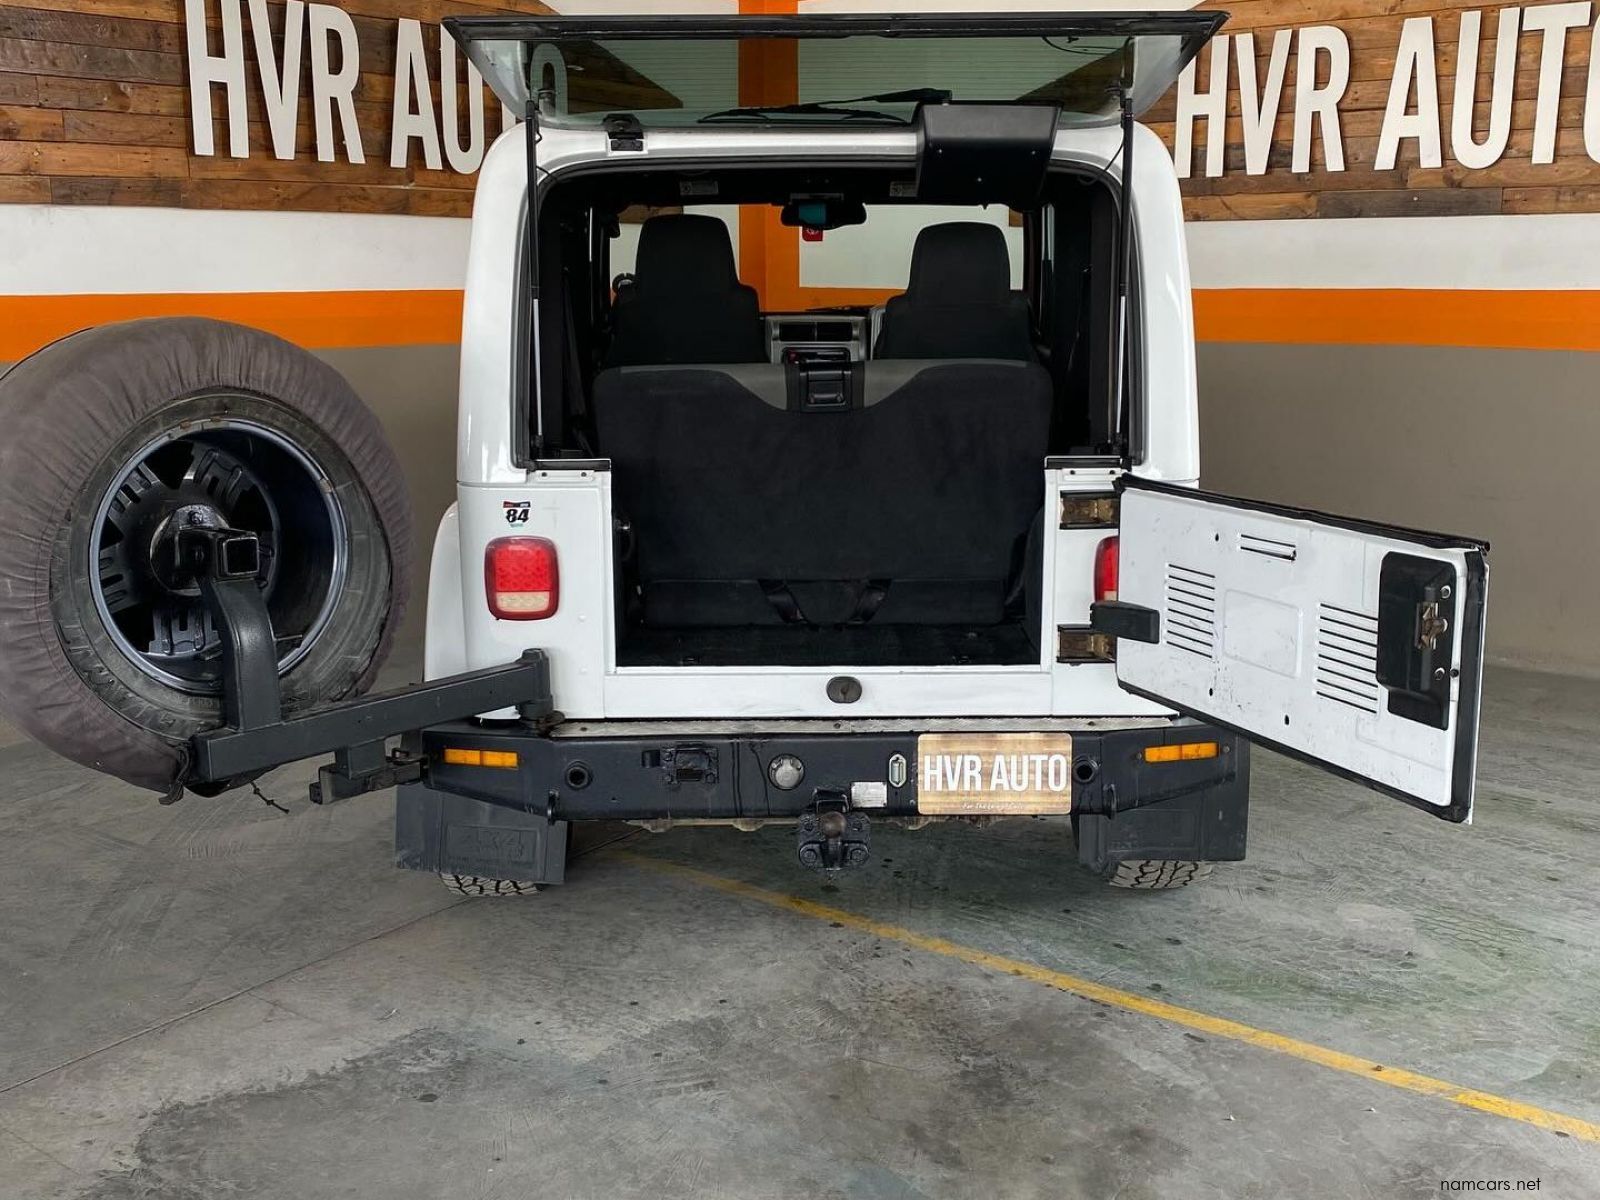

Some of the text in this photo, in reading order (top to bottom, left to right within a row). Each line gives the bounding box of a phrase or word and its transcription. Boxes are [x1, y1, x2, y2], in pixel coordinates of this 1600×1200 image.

[186, 0, 366, 164] HVR
[1174, 2, 1600, 178] HVR AUT
[506, 509, 530, 523] 84
[924, 754, 1067, 792] HVR AUTO
